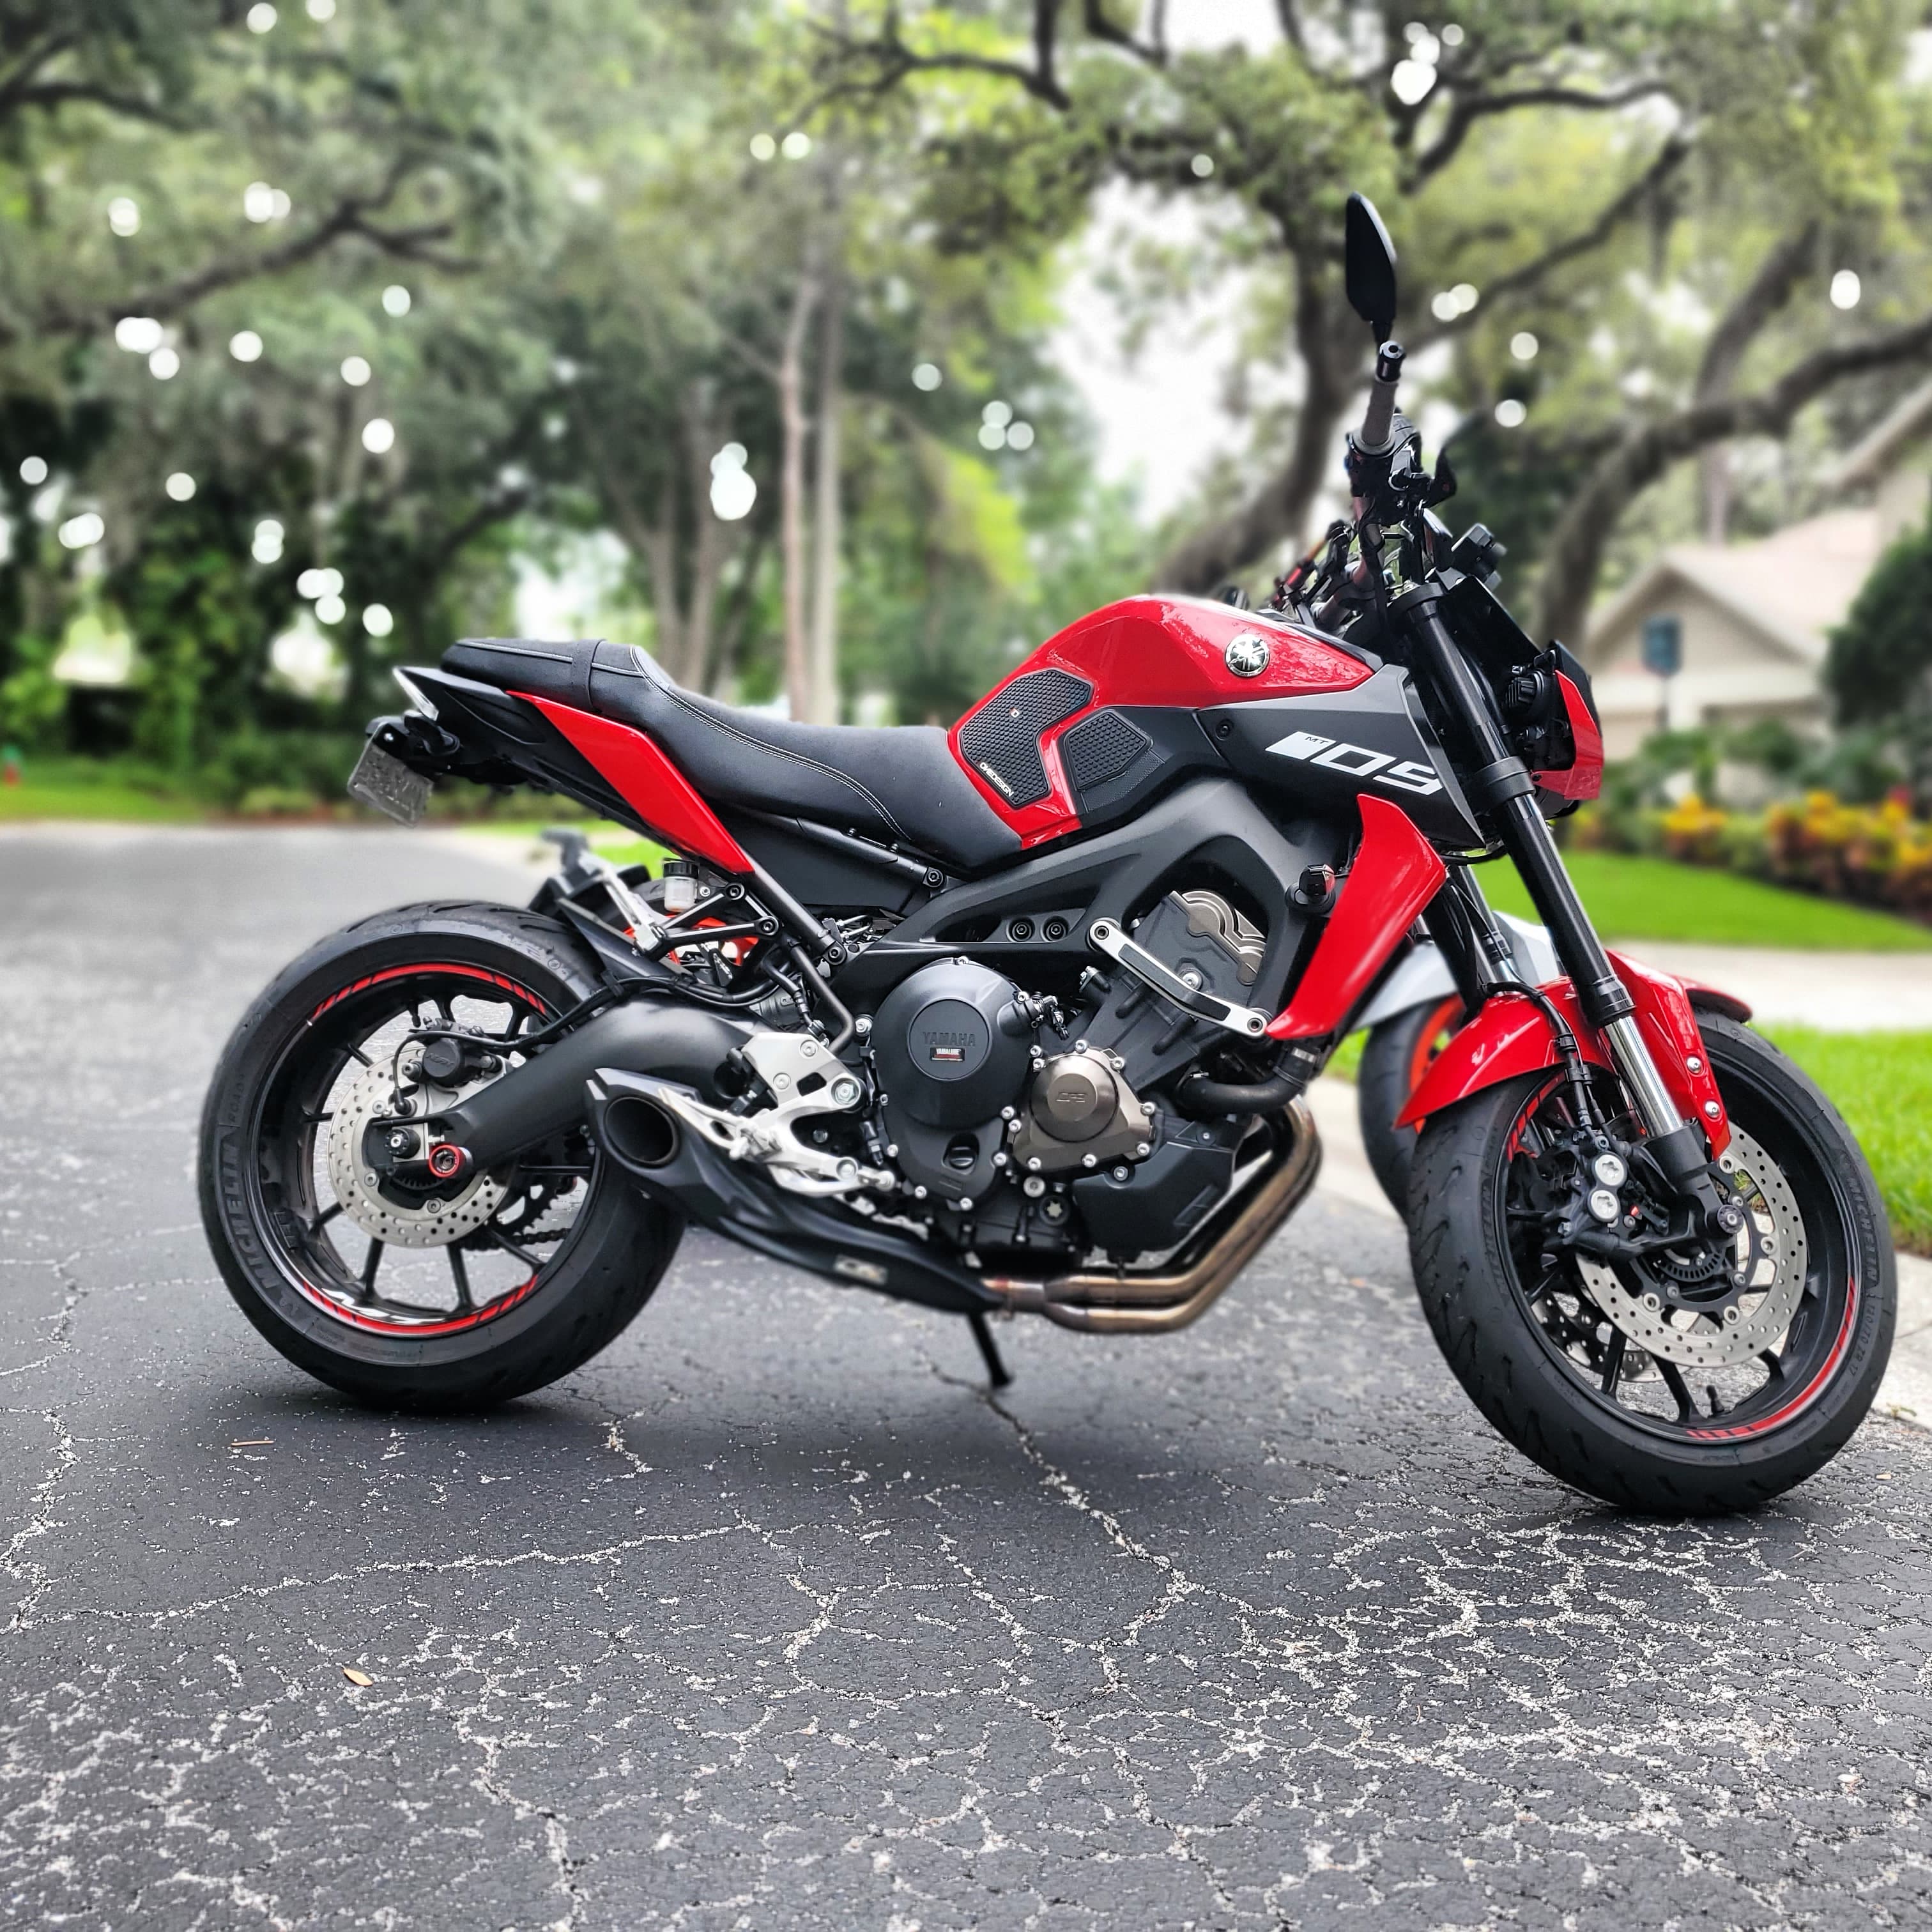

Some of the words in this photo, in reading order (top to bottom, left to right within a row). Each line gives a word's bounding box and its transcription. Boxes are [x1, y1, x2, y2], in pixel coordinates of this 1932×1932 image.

[1305, 736, 1330, 744] MT
[979, 762, 1014, 797] ONEDESIGN
[1310, 743, 1443, 795] 09
[923, 1032, 976, 1046] YAMAHA
[222, 1146, 280, 1289] MICHELIN
[1847, 1177, 1877, 1282] MICHELIN
